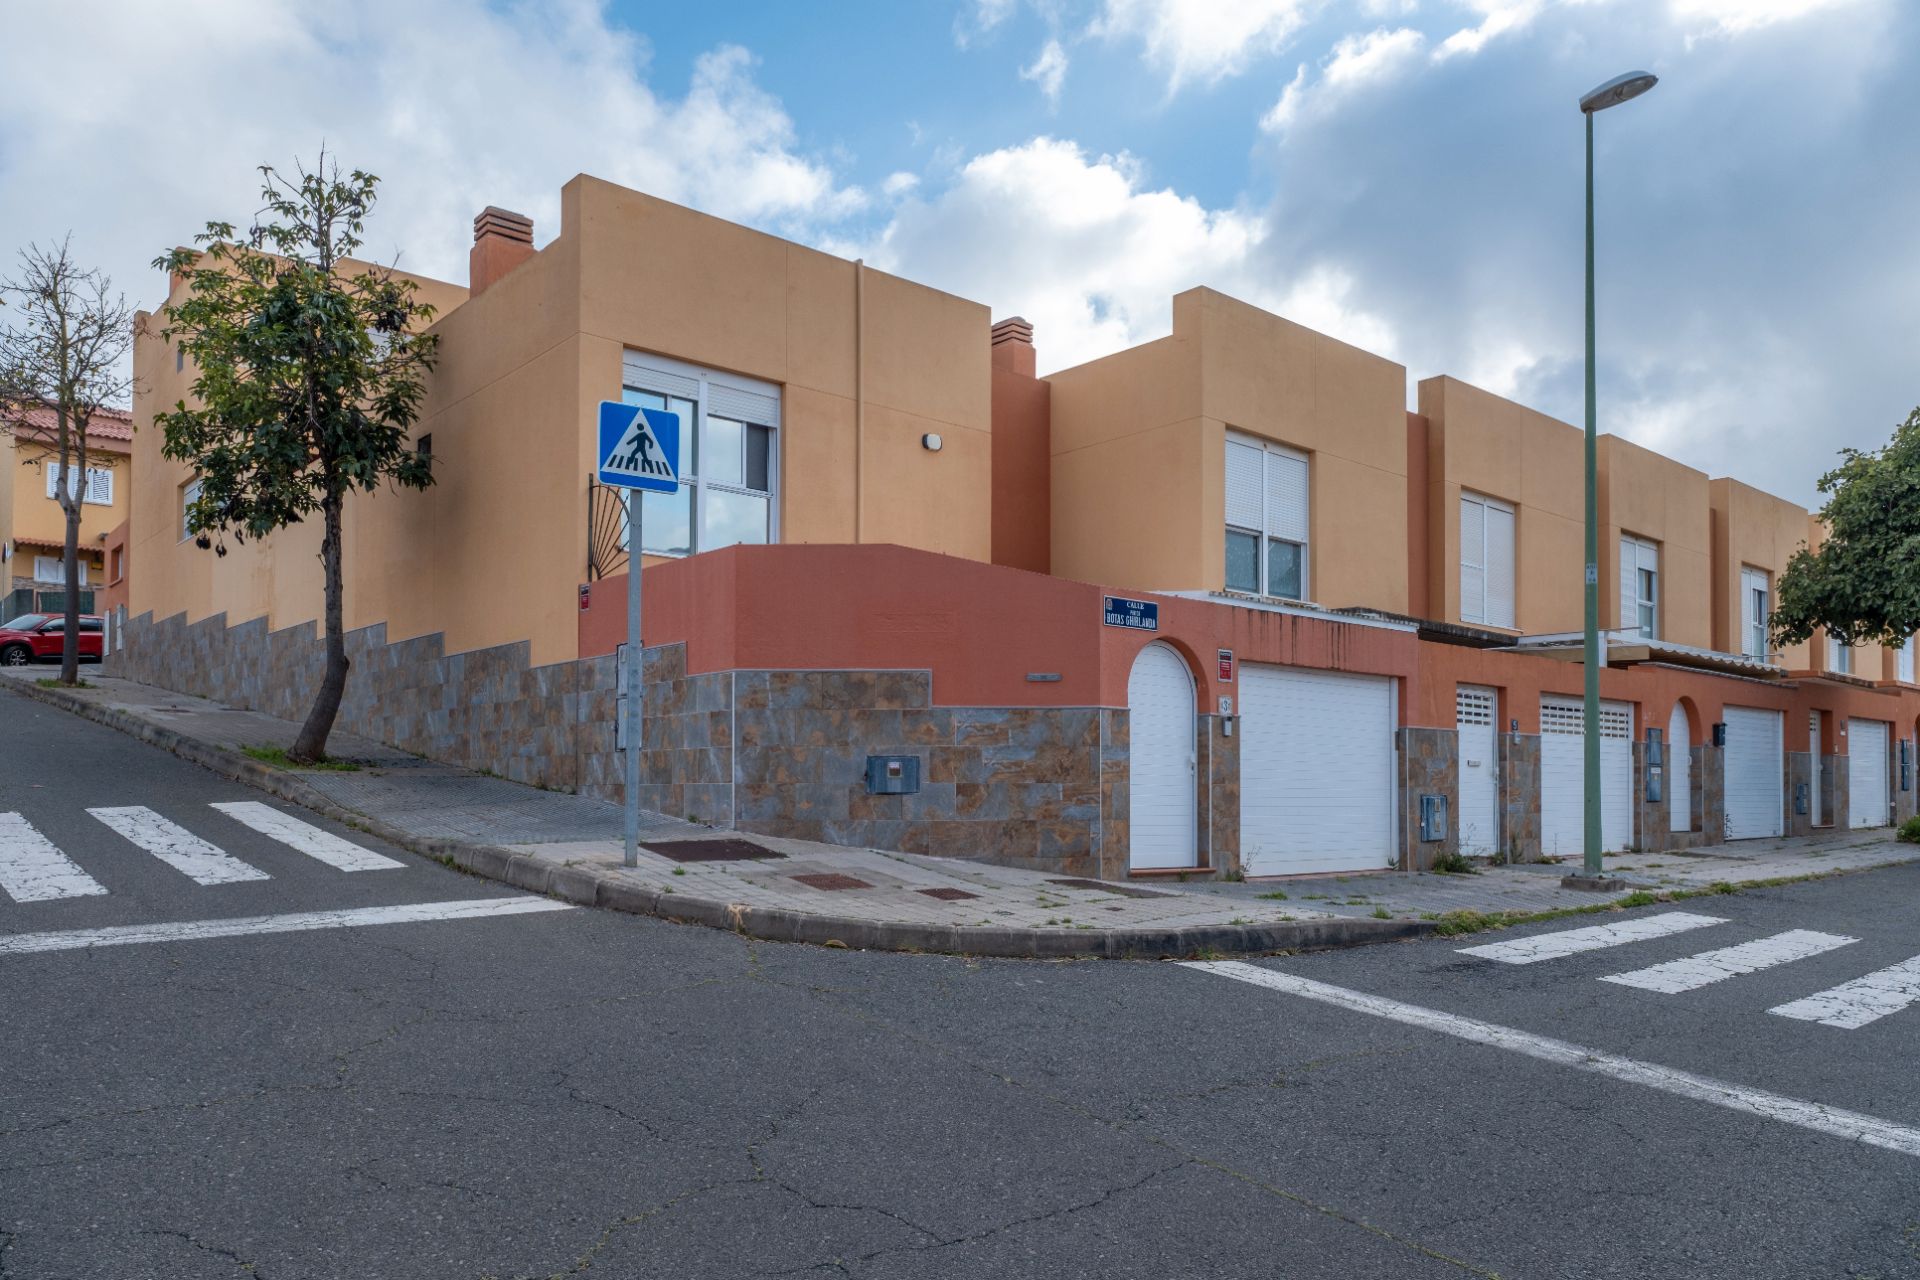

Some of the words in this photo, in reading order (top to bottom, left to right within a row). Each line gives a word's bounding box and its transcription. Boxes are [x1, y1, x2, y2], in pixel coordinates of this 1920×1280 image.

[1126, 601, 1145, 610] CALLE
[1106, 612, 1125, 625] BOTAS
[1125, 615, 1156, 629] GHIRLANDA
